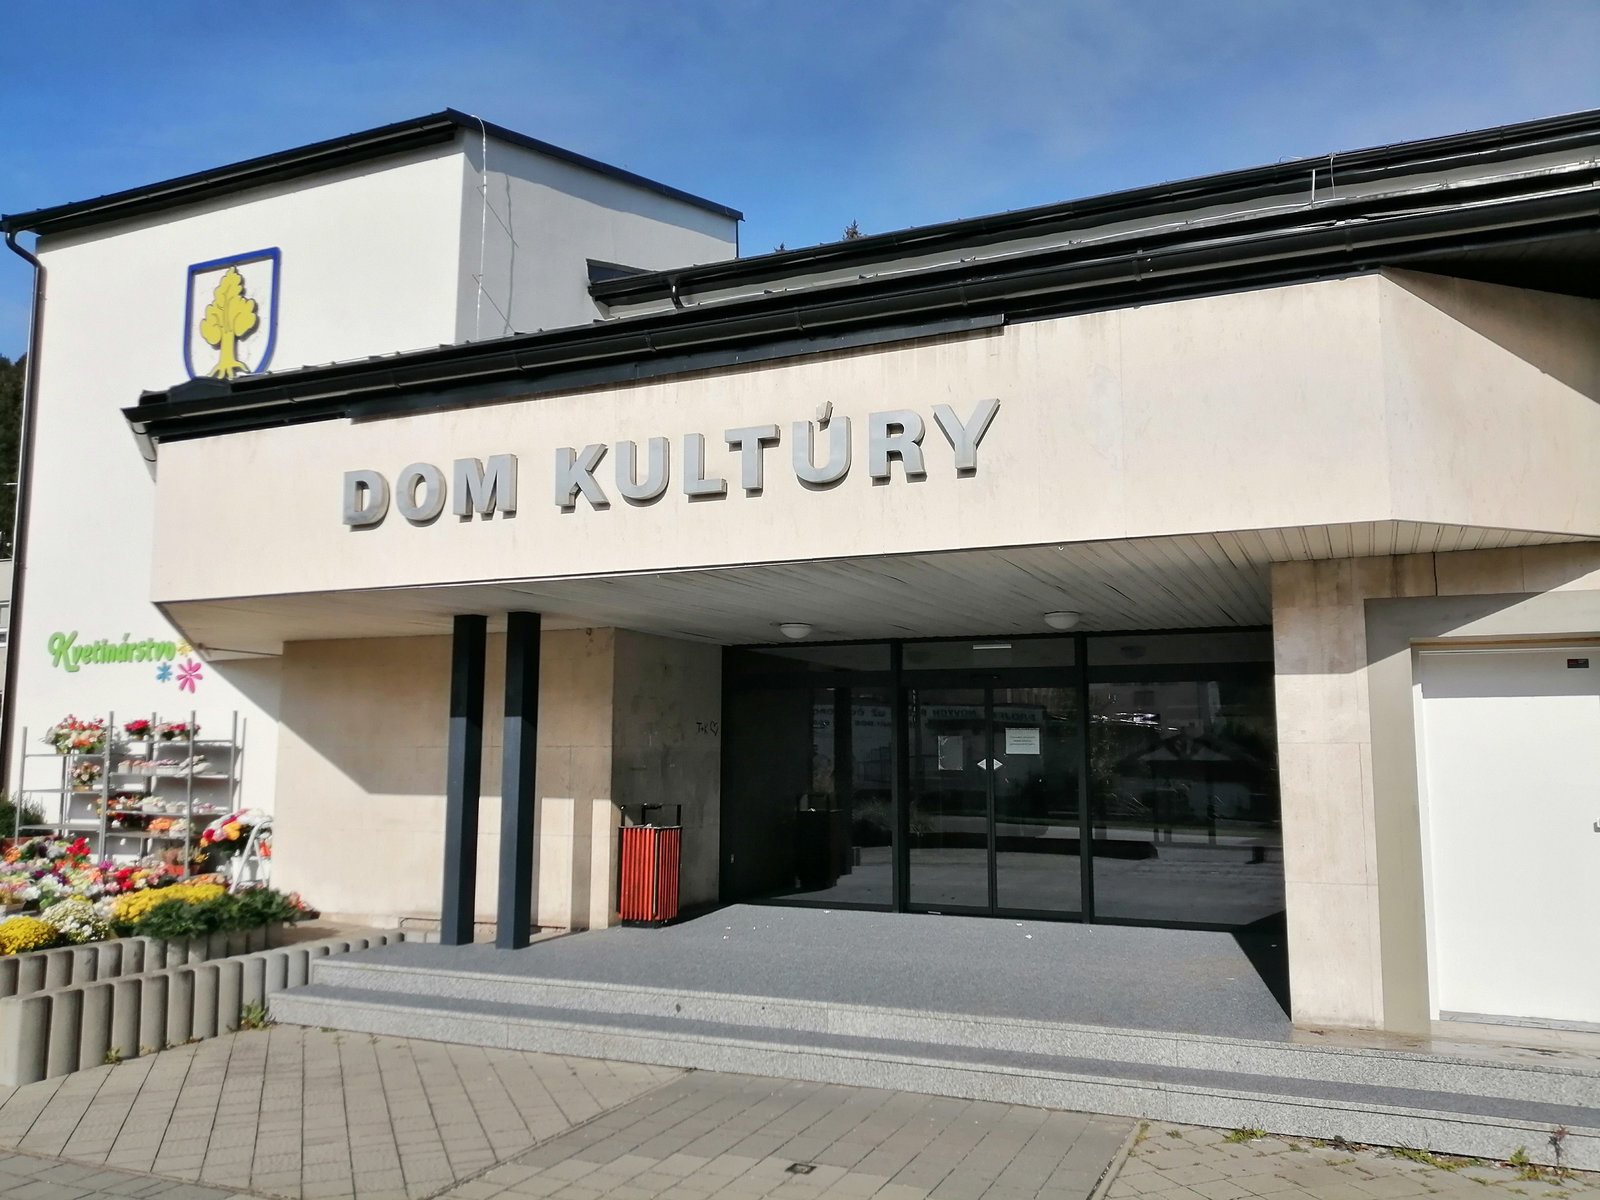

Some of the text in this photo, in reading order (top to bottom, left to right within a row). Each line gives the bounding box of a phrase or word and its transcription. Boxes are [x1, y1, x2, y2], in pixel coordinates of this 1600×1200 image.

[343, 398, 1001, 532] DOM KULTÚRY
[48, 630, 177, 673] Kvetinárstvo
